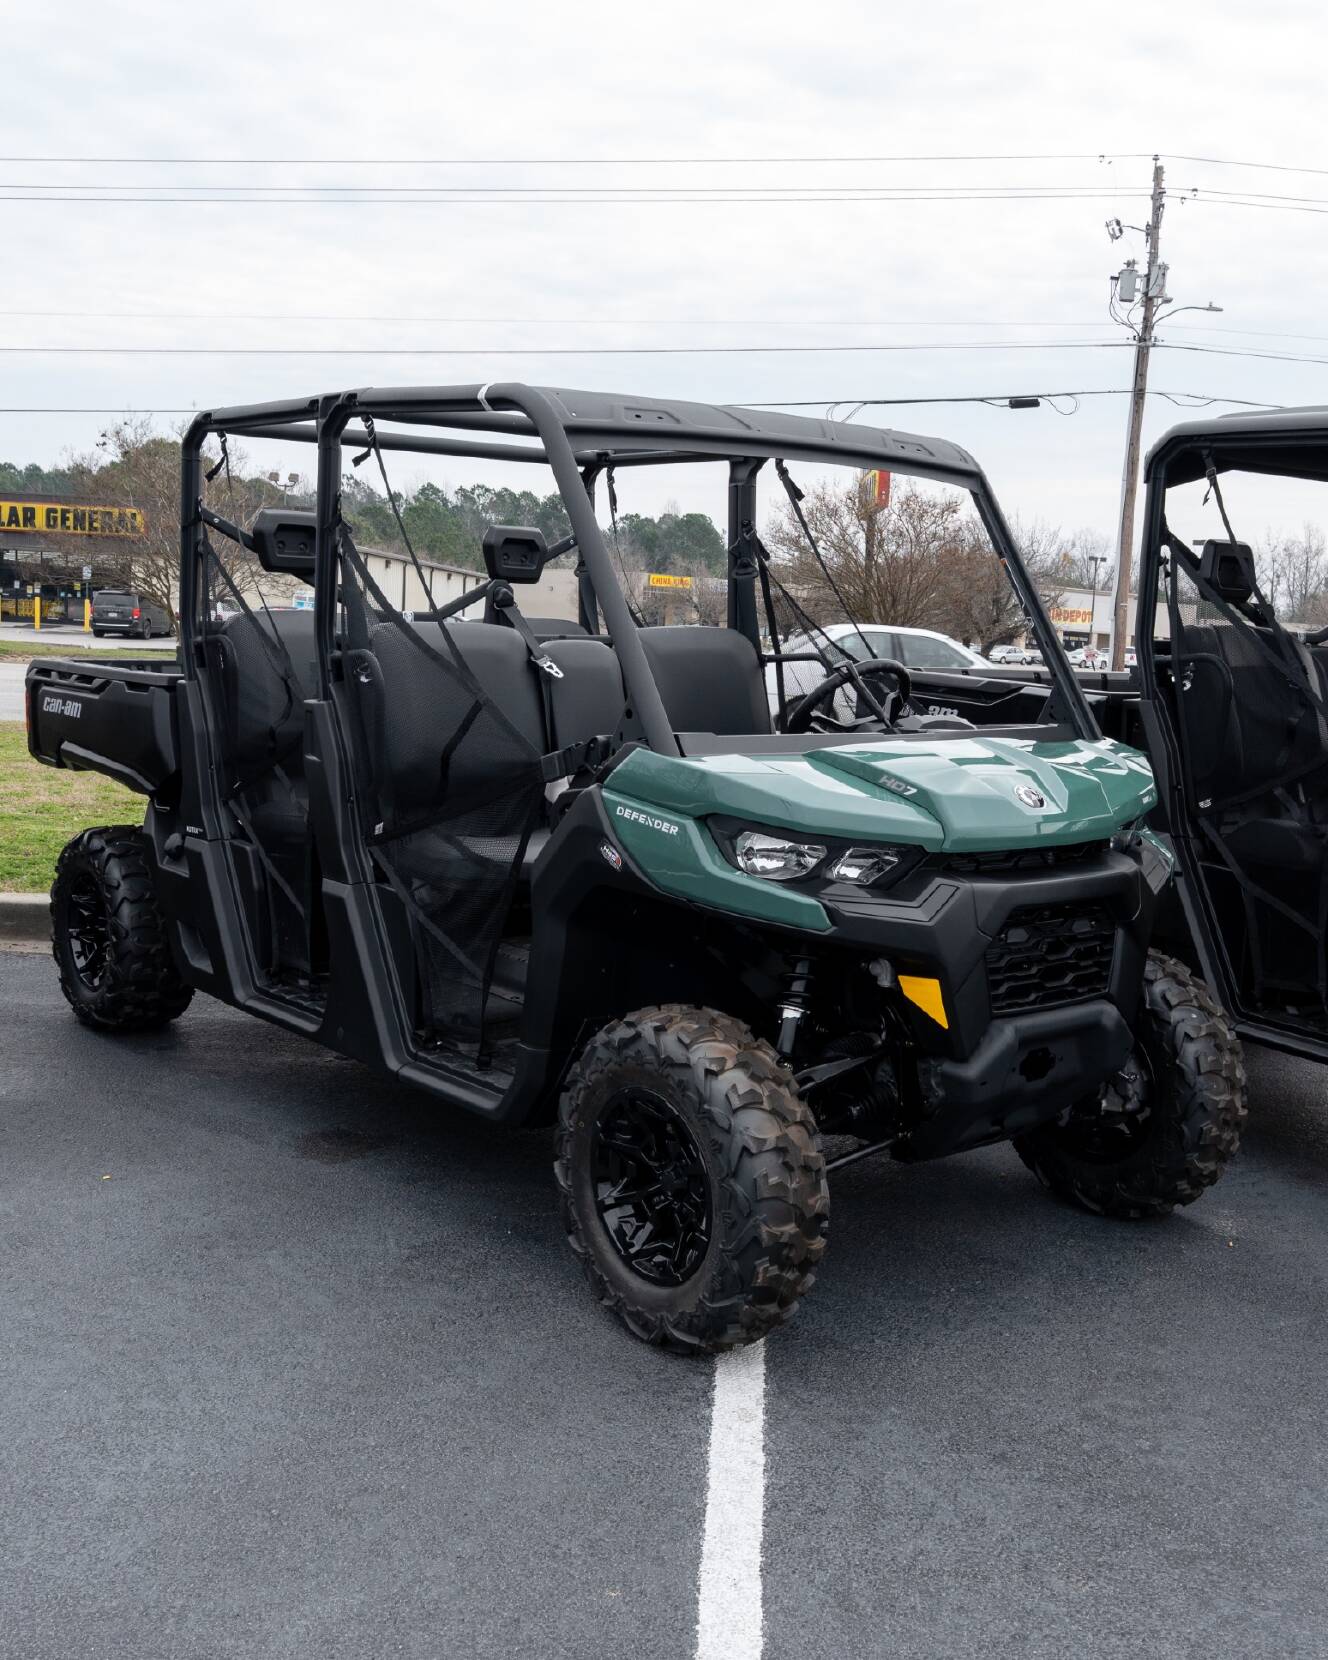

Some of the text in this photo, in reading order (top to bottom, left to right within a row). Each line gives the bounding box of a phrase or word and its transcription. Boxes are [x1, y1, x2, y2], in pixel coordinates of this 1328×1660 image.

[45, 507, 138, 533] GENERAL
[652, 576, 672, 585] CHINA
[879, 775, 918, 795] HD7
[616, 806, 679, 835] DEFENDER
